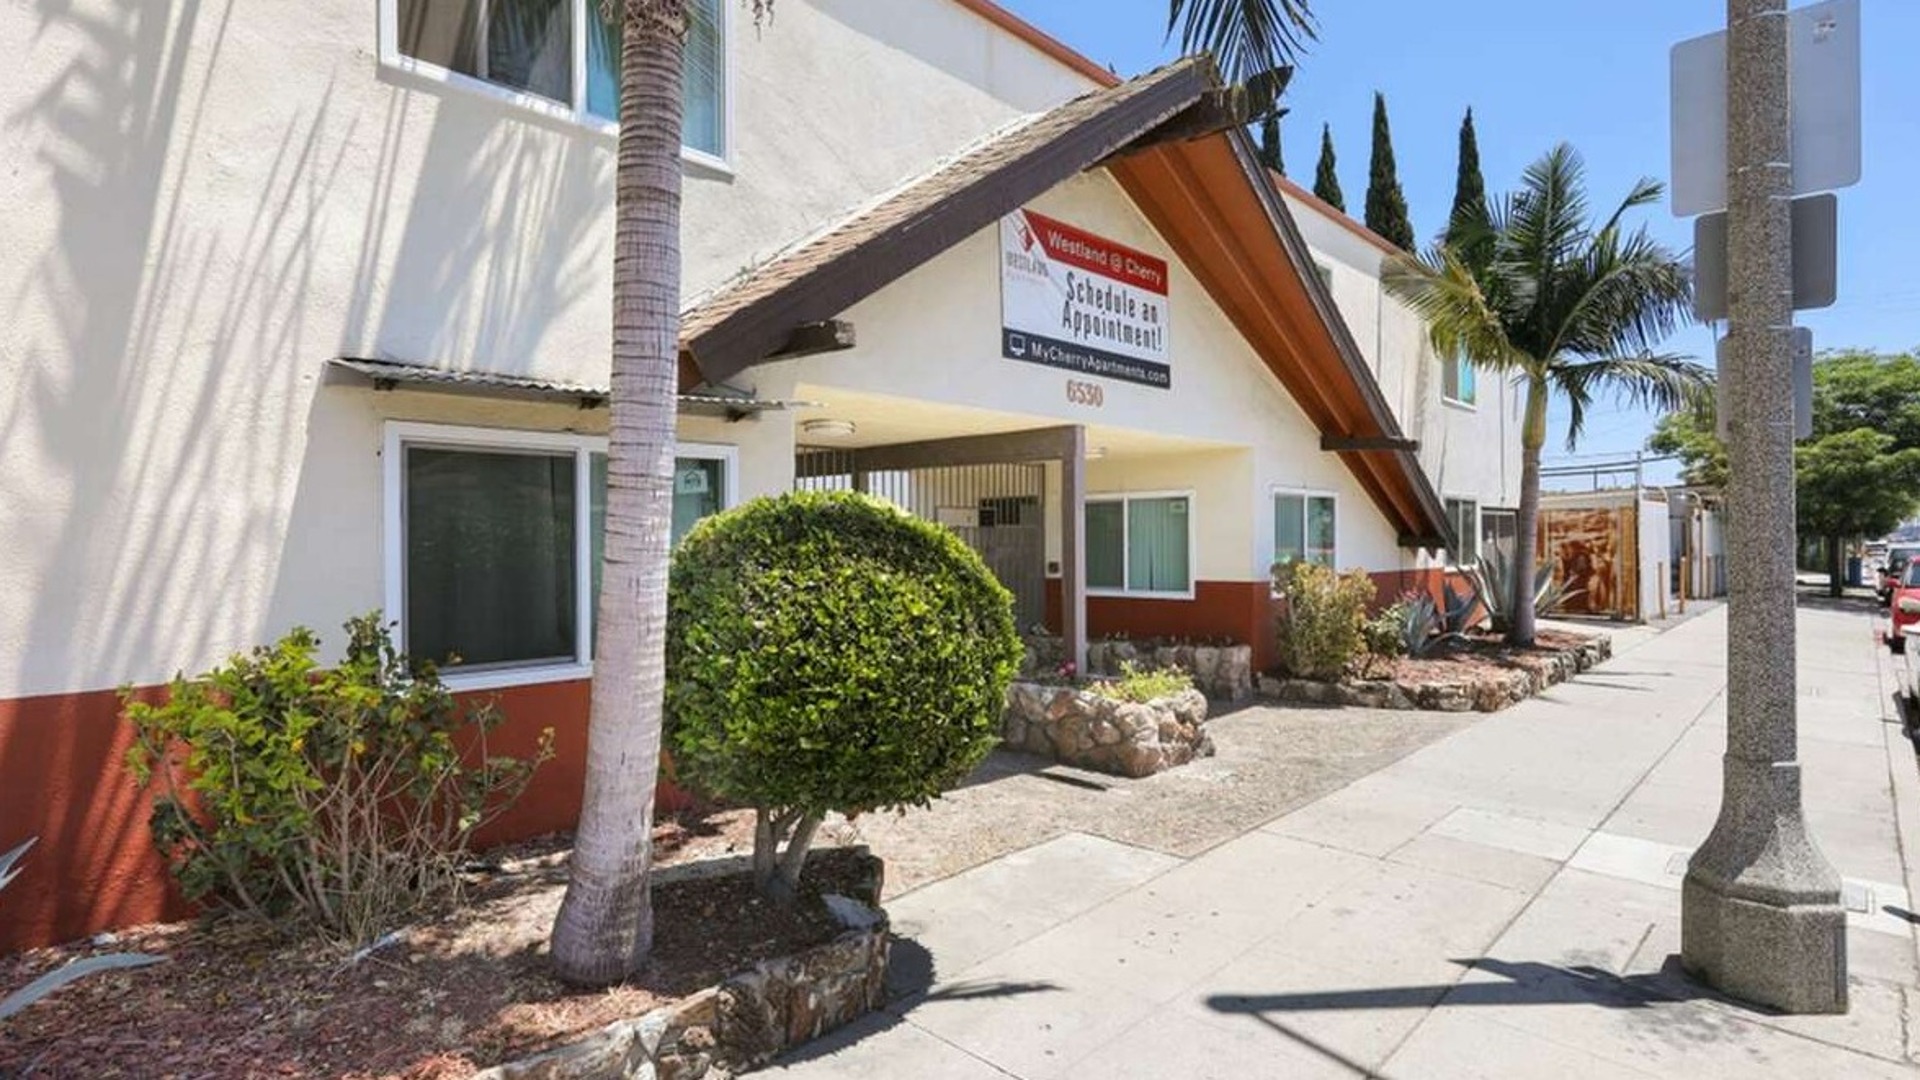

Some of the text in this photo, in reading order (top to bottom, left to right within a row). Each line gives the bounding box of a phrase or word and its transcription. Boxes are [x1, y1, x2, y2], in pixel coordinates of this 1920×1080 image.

[1048, 231, 1161, 285] Westland @ Cherry
[1066, 271, 1135, 319] Schedule
[1143, 302, 1158, 324] an
[1062, 300, 1162, 351] Appointment!
[1031, 342, 1168, 383] MyCherryApartments.com
[1066, 378, 1104, 408] 6530
